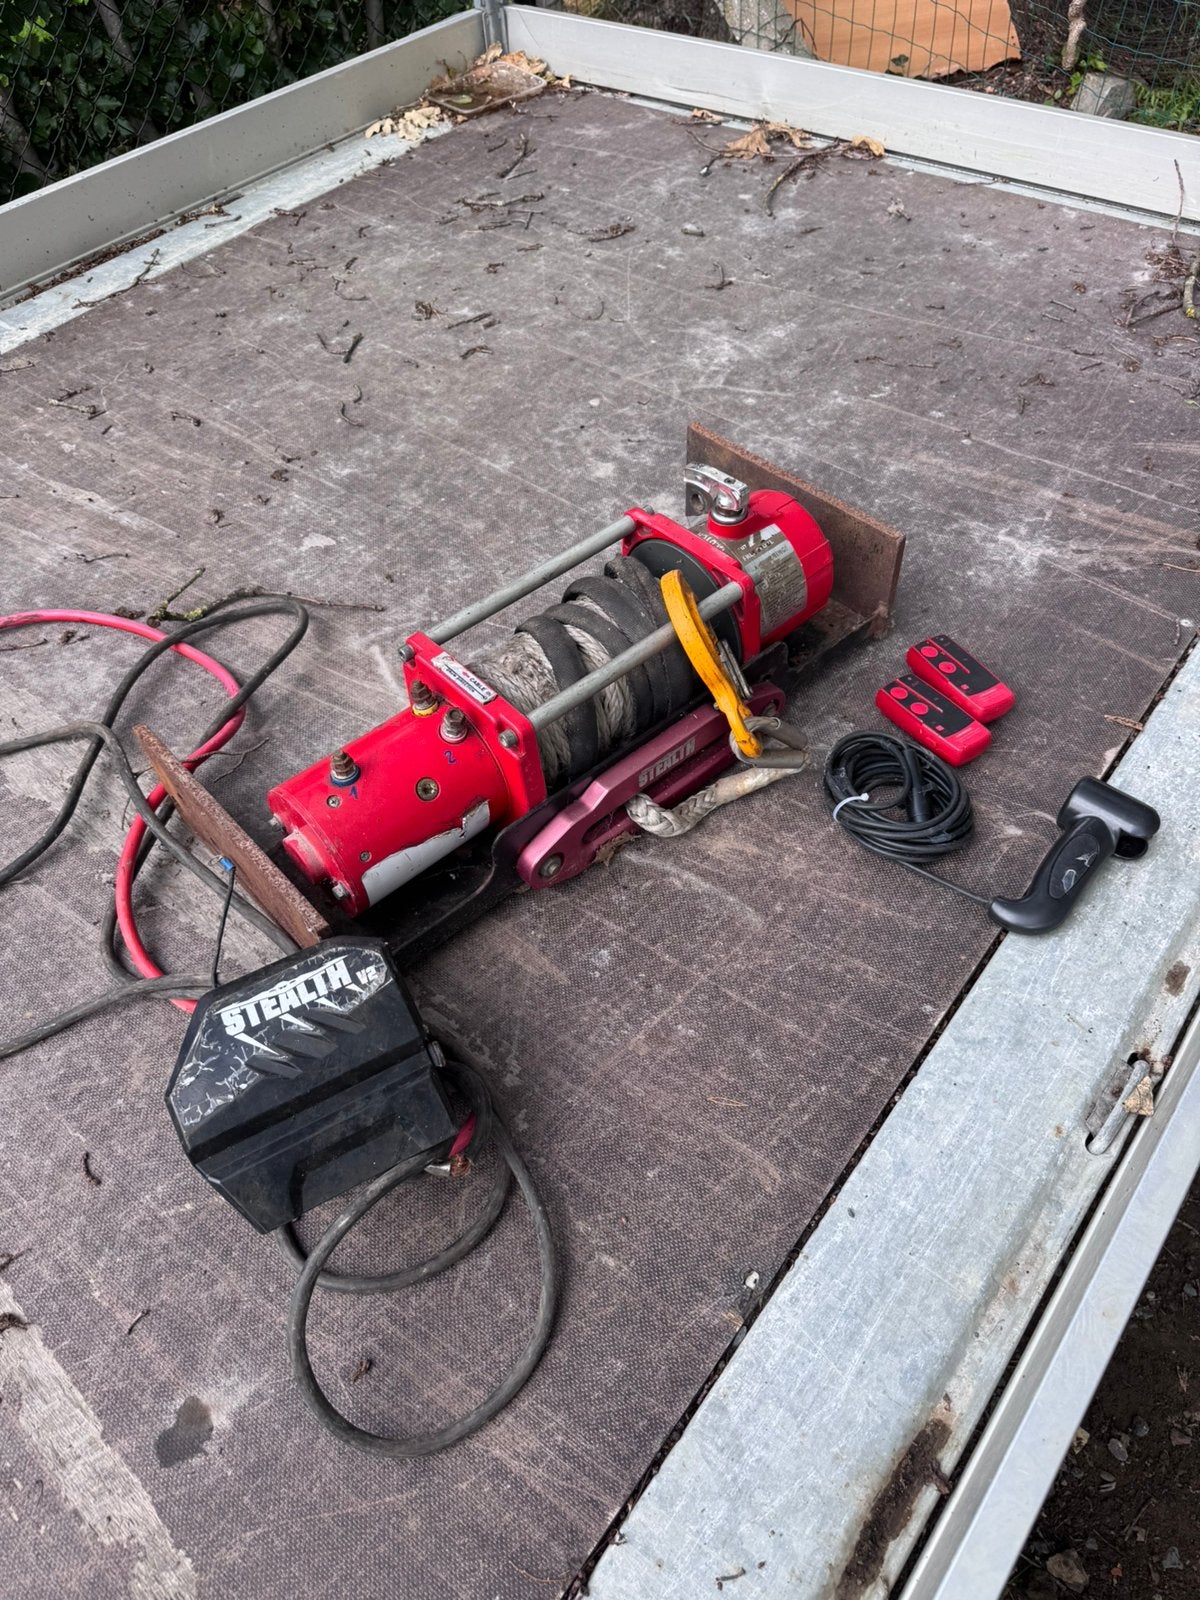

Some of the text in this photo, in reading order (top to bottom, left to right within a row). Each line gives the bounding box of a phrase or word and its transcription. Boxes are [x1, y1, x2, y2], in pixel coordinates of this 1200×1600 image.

[469, 677, 486, 692] CABLE
[444, 750, 456, 764] 2
[639, 737, 696, 788] STEALTH
[221, 959, 378, 1036] STEALTH V2
